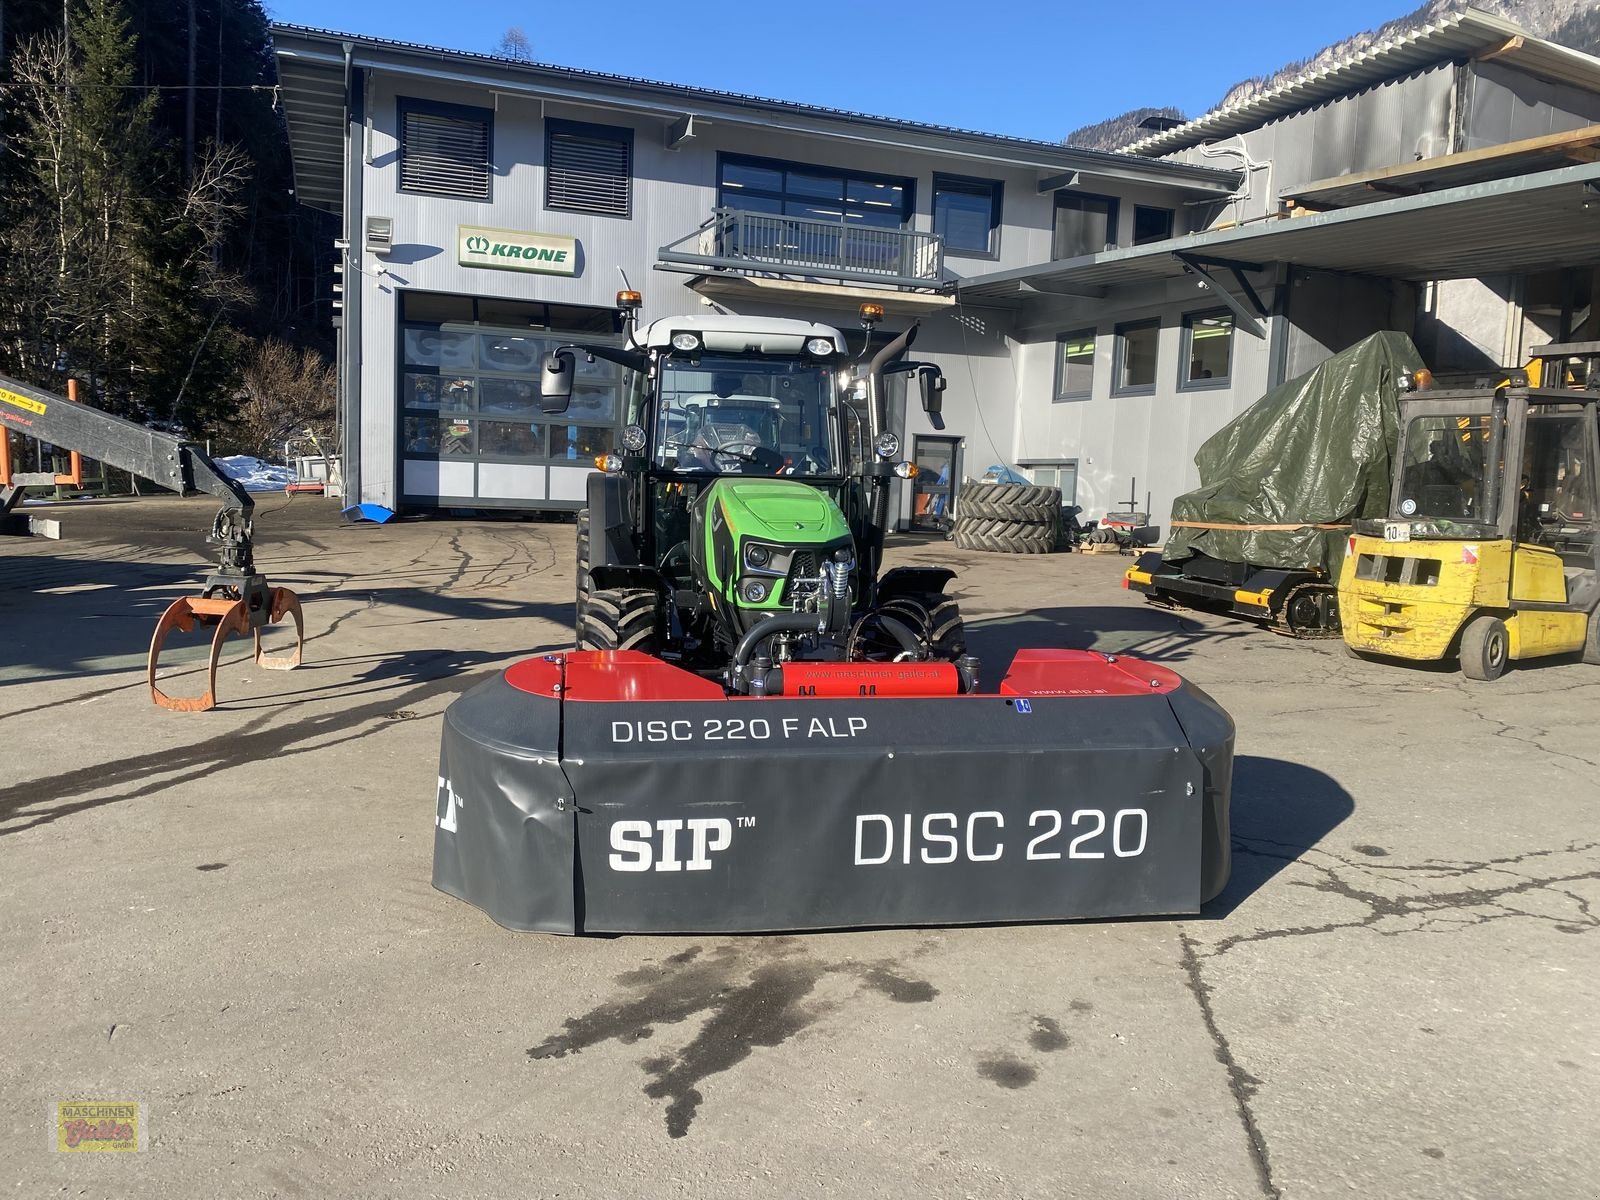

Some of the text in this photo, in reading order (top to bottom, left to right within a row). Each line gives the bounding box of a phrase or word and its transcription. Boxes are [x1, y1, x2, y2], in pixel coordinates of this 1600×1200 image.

[491, 243, 567, 262] KRONE
[1386, 526, 1398, 540] 10
[805, 669, 940, 680] www.maschinen-gailer.at
[611, 717, 868, 742] DISC 220 F ALP
[609, 818, 732, 872] SIP
[853, 808, 1149, 866] DISC 220
